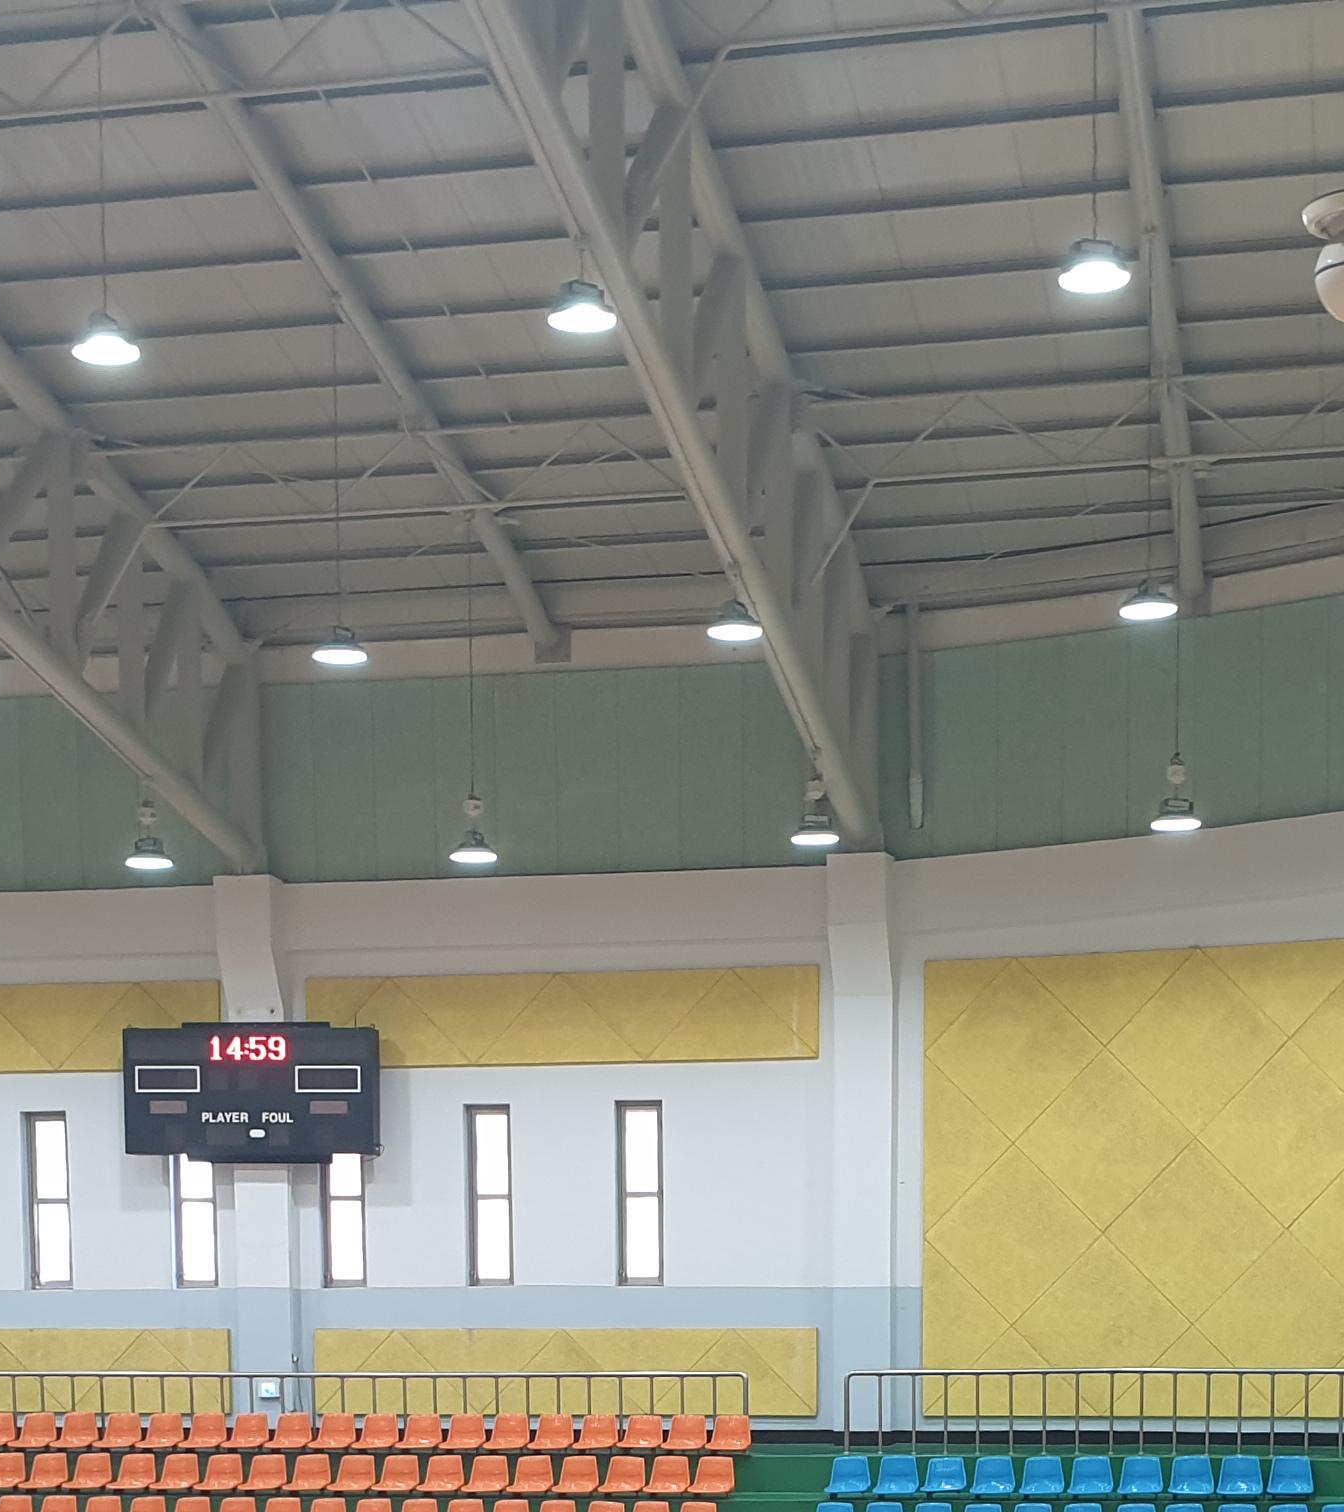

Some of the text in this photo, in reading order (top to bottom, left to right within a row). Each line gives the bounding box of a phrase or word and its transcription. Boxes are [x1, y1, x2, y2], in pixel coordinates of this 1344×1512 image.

[209, 1035, 286, 1060] 14:59
[201, 1111, 294, 1123] PLAYER FOUL
